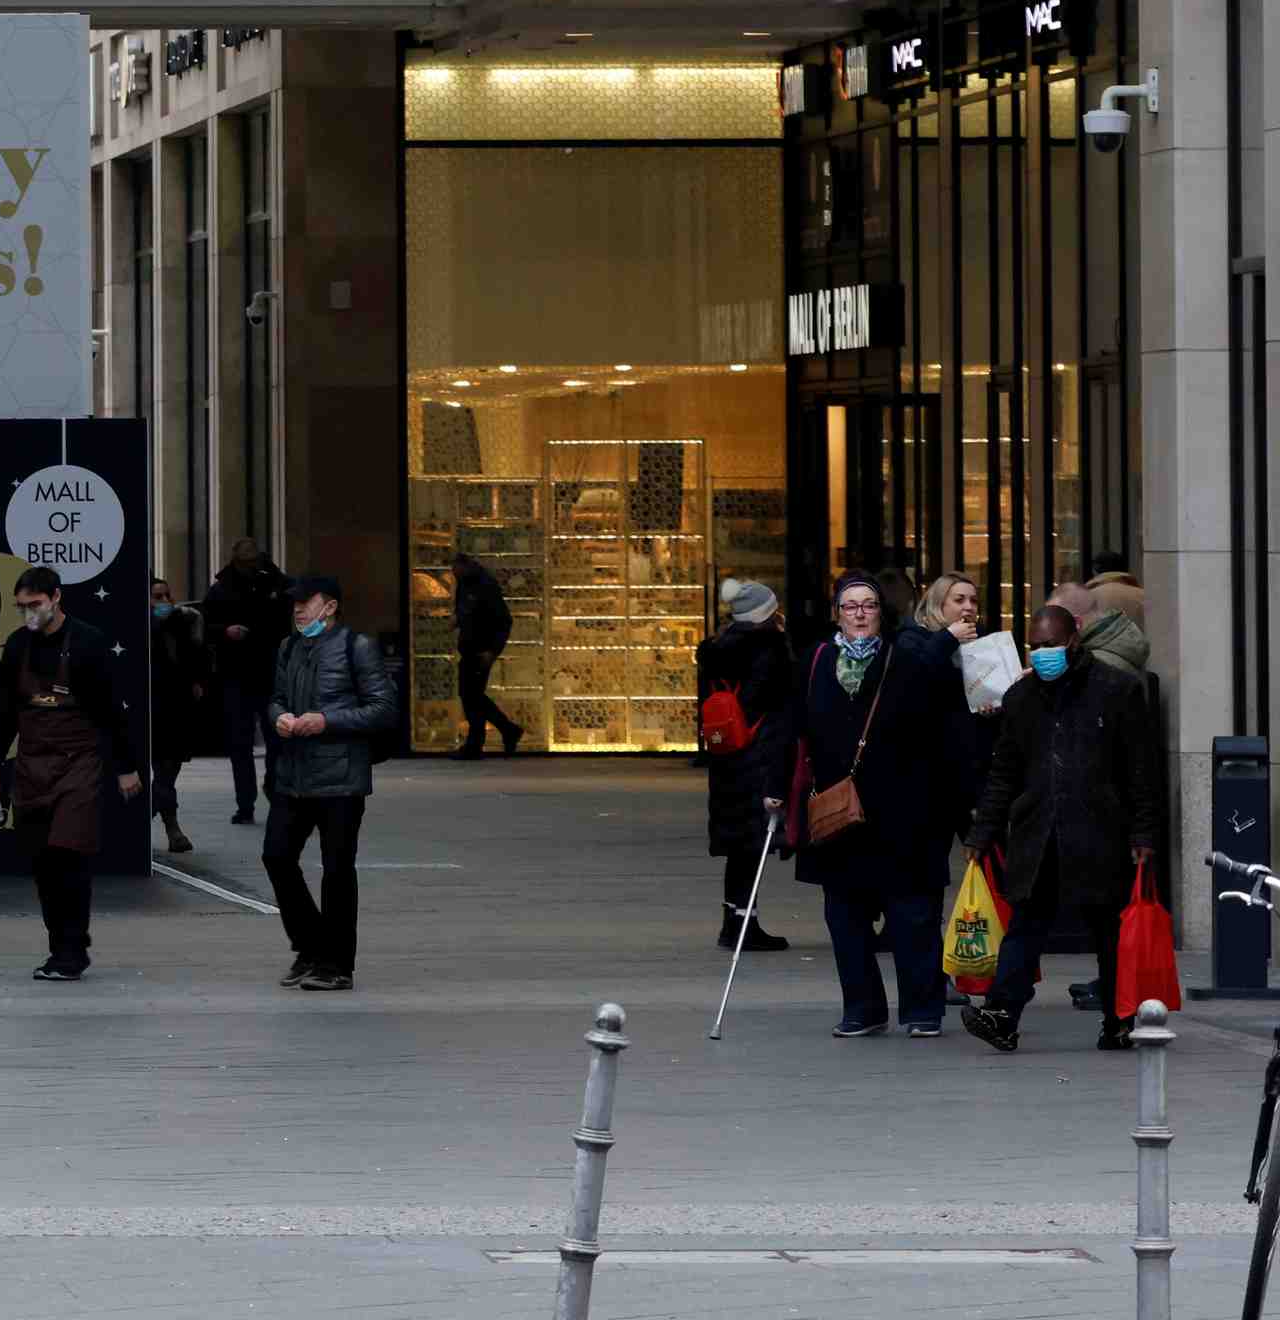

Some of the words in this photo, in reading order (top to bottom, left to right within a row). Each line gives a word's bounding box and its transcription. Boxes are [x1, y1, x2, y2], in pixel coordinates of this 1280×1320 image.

[35, 481, 95, 502] MALL
[48, 511, 81, 533] OF
[27, 542, 104, 564] BERLIN
